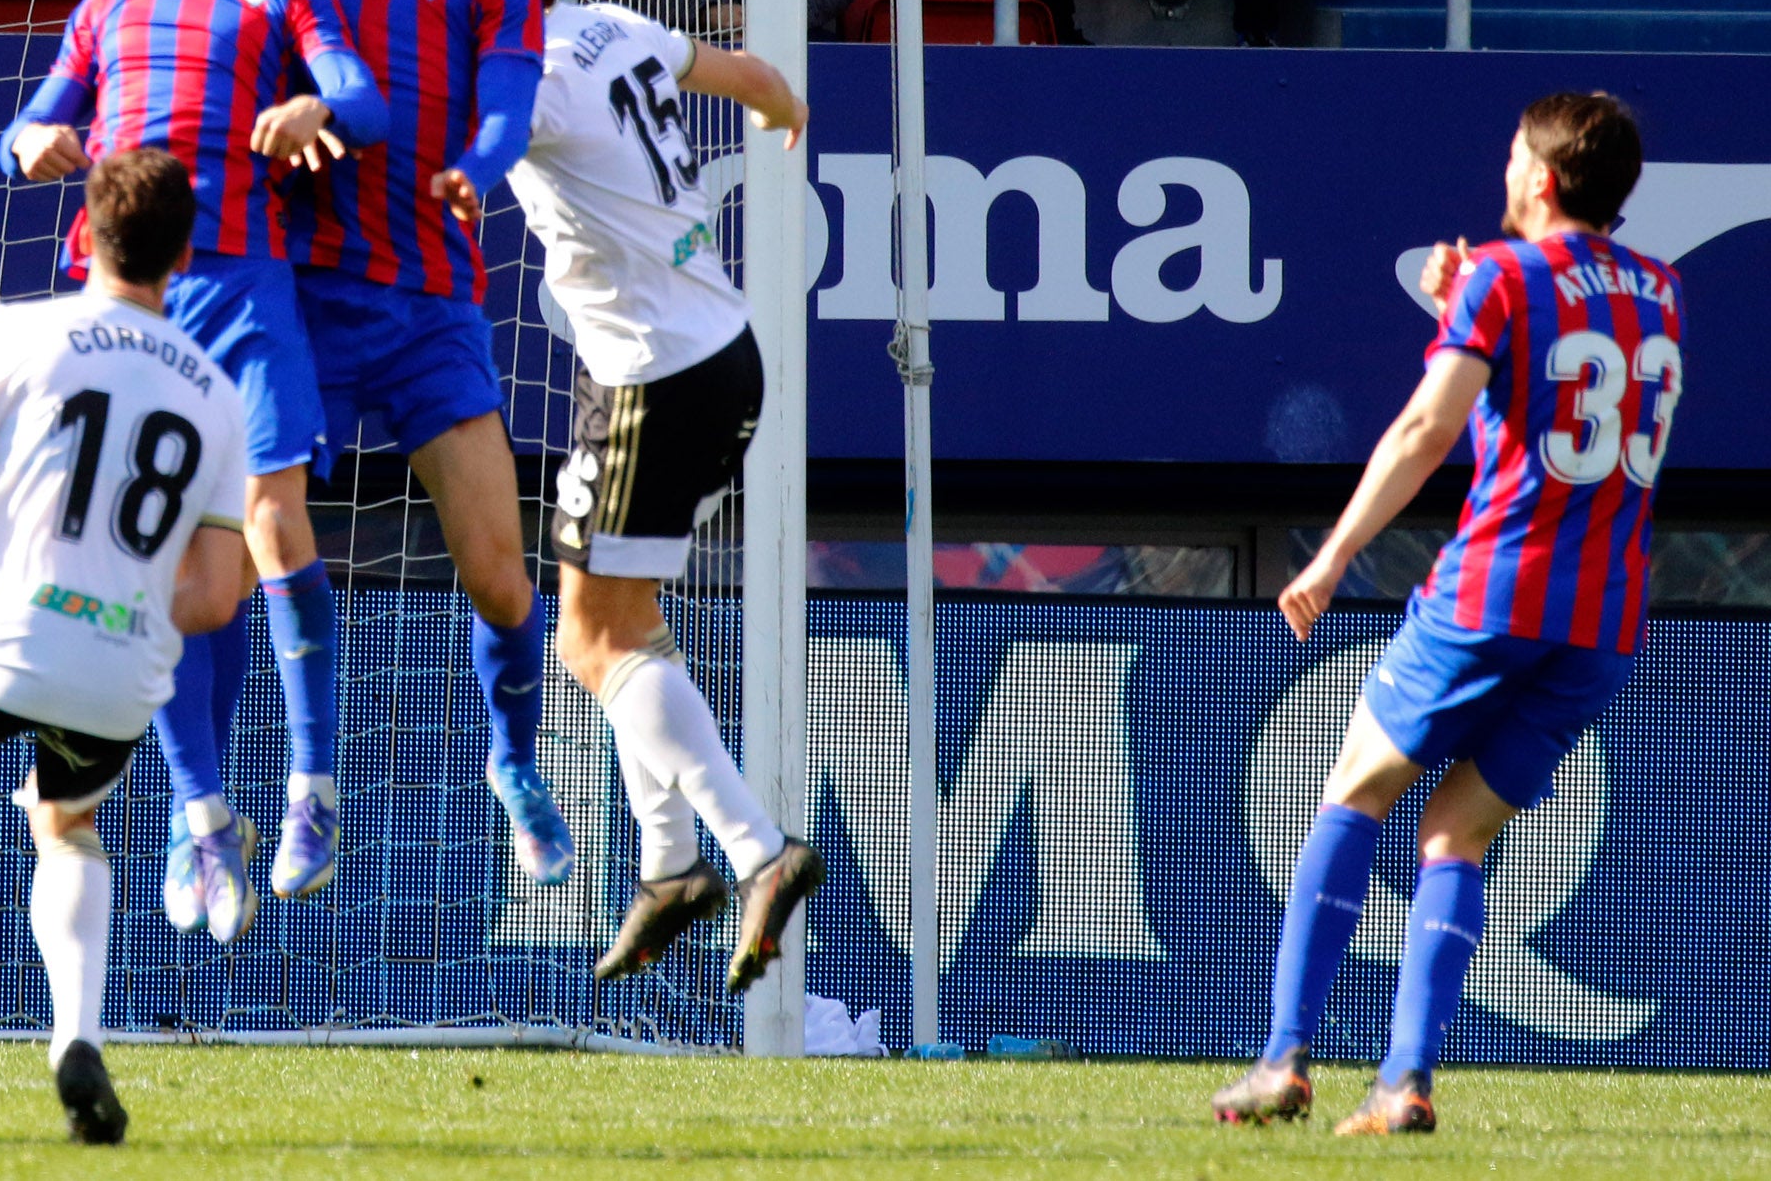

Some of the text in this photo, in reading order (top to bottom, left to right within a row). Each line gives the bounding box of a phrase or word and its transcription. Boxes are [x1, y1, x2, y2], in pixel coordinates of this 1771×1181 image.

[609, 55, 700, 208] 15
[1555, 262, 1675, 315] ATIENZA
[53, 388, 202, 564] 18
[1539, 329, 1683, 489] 33
